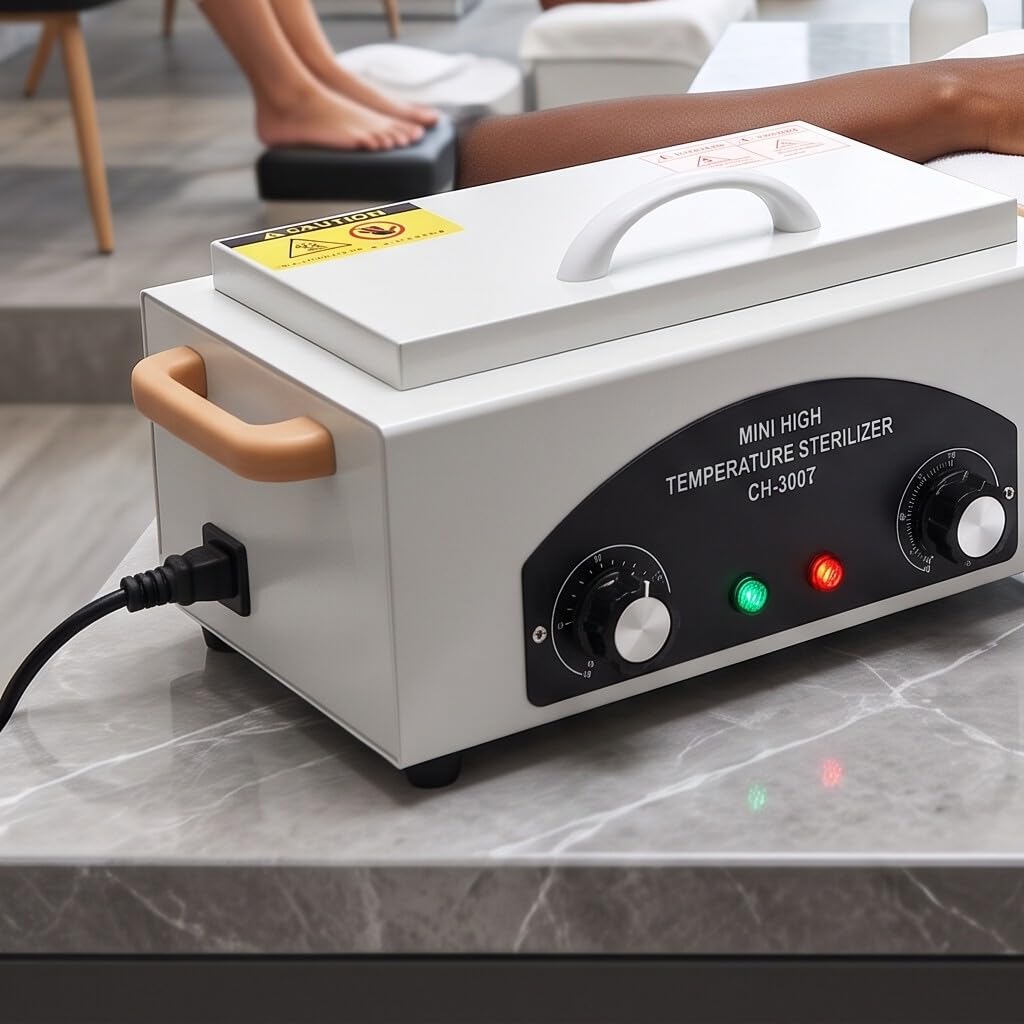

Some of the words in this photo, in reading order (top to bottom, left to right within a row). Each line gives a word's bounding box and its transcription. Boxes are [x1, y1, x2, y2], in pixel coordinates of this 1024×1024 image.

[286, 209, 387, 235] CAUTION
[739, 418, 775, 446] MINI
[780, 406, 822, 434] HIGH
[665, 443, 795, 495] TEMPERATURE
[799, 416, 894, 458] STERILIZER
[748, 466, 817, 501] CH-3007
